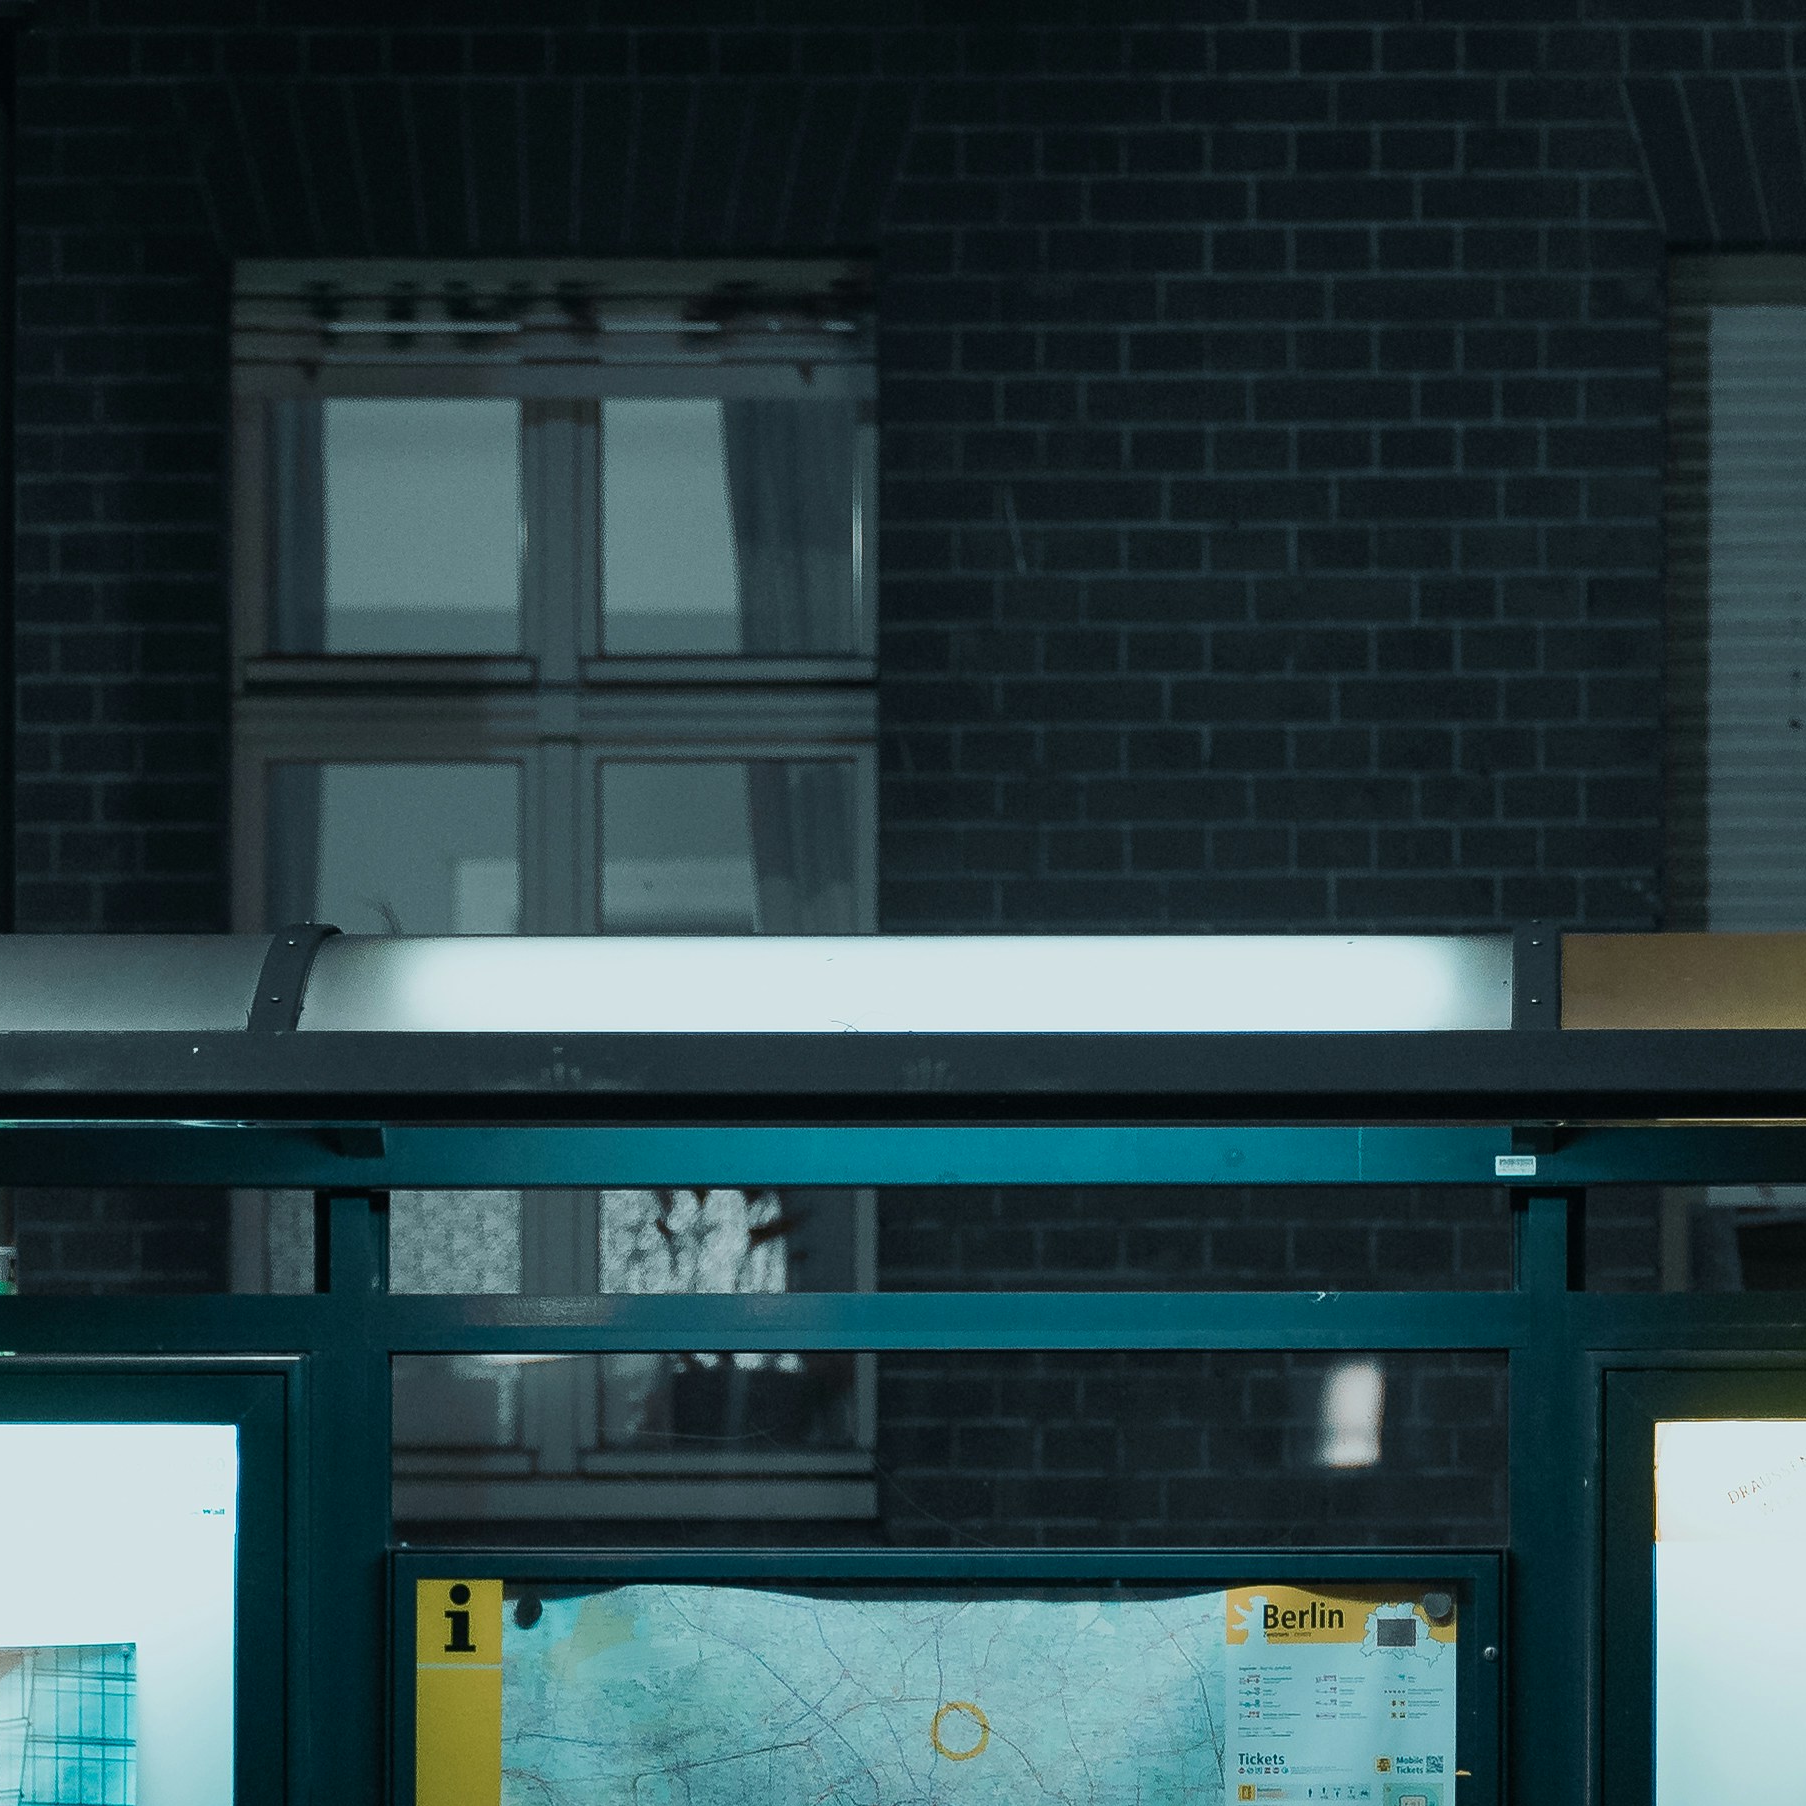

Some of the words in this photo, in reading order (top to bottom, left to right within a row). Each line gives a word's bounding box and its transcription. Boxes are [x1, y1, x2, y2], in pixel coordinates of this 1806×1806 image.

[1263, 1601, 1345, 1630] Berlin
[1238, 1751, 1286, 1765] Tickets
[1396, 1755, 1424, 1764] Mobile
[1396, 1765, 1424, 1774] Tickets
